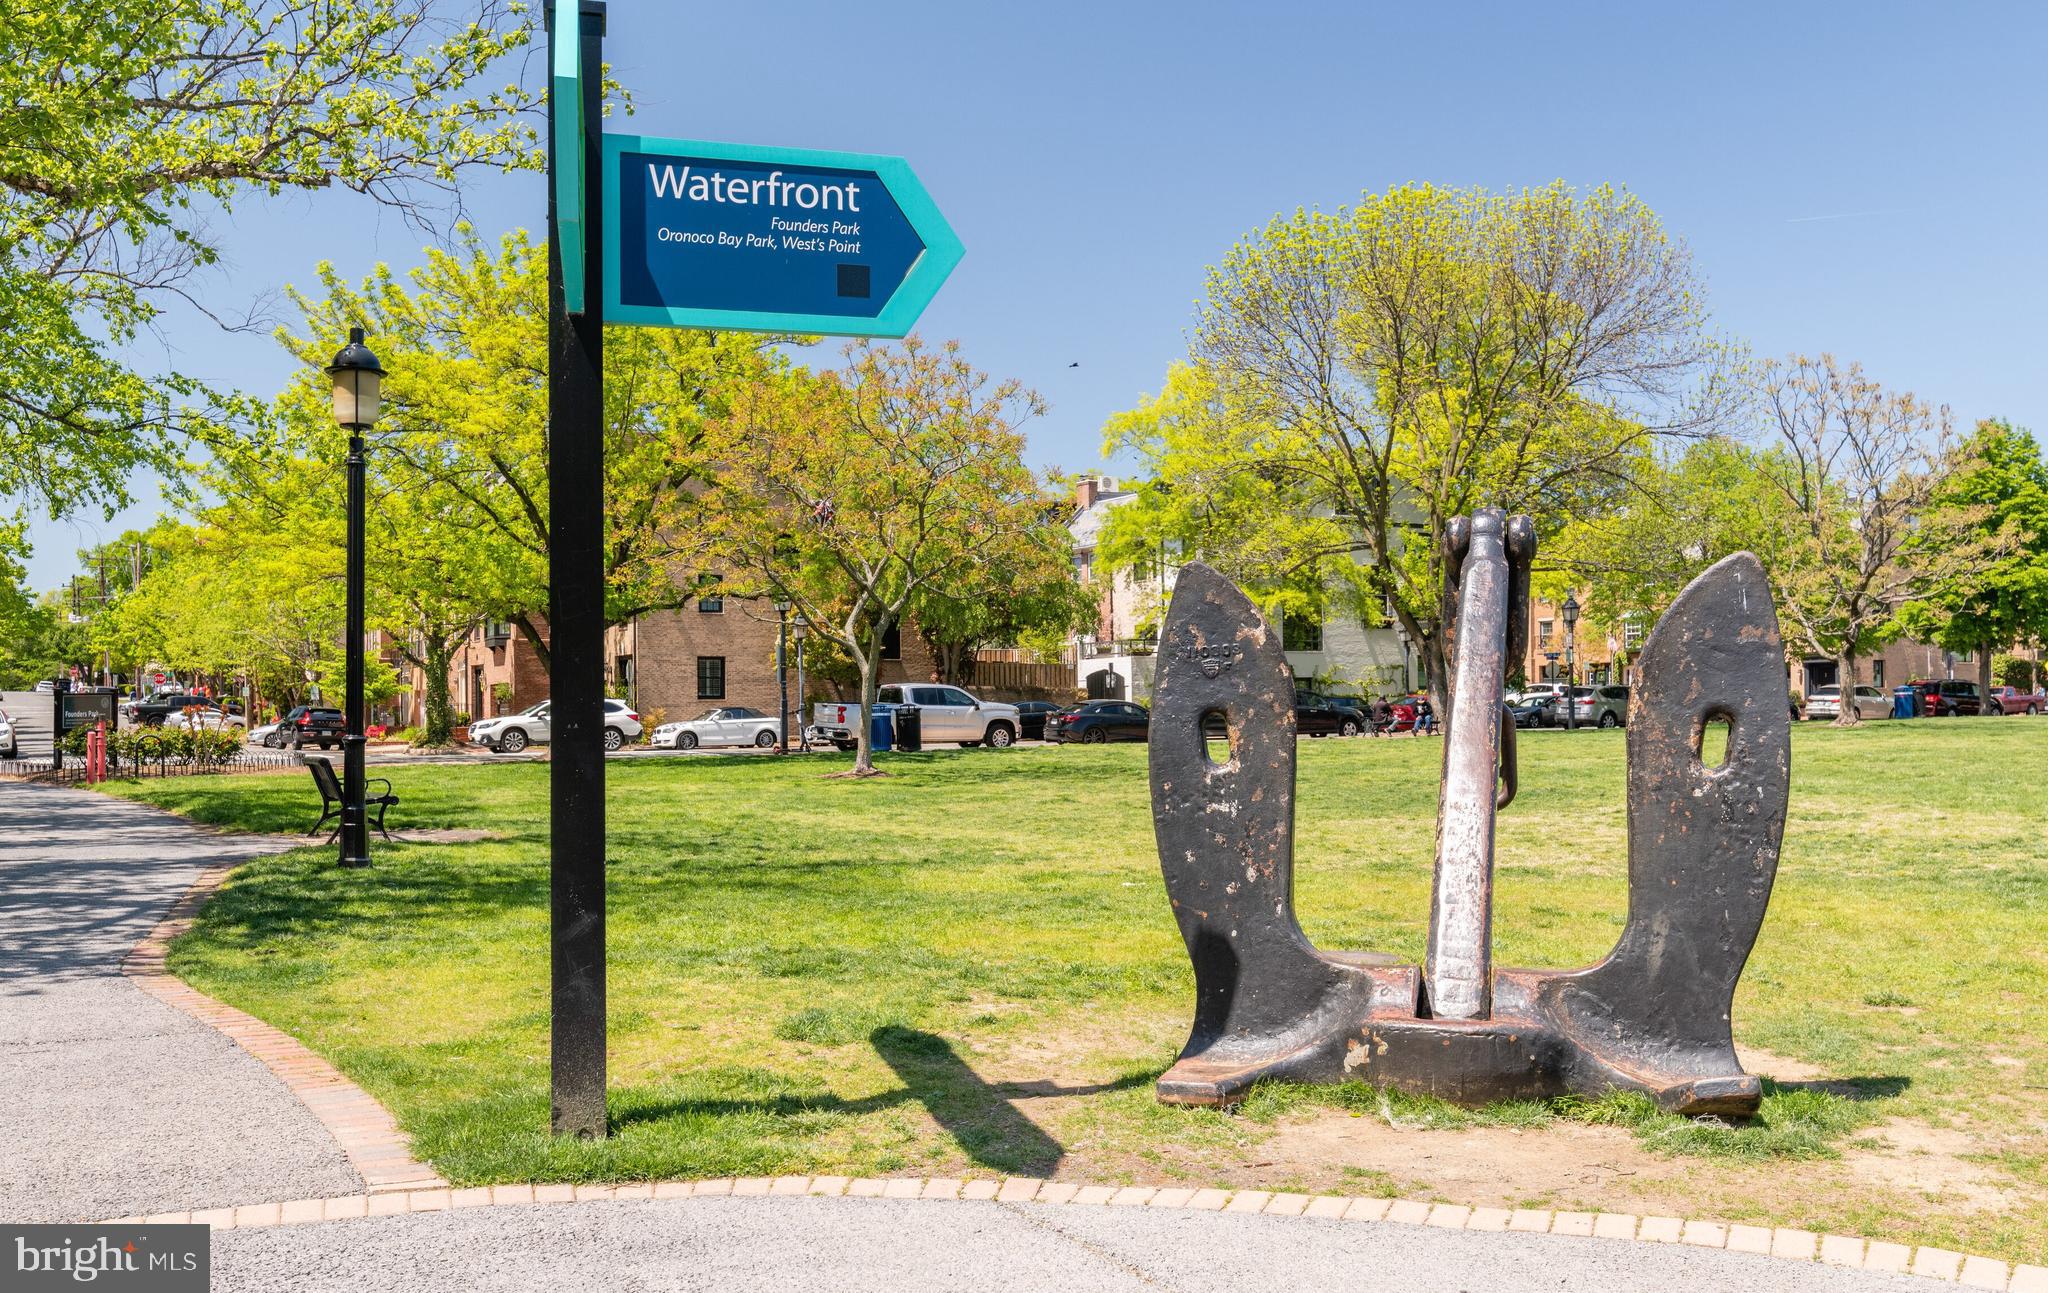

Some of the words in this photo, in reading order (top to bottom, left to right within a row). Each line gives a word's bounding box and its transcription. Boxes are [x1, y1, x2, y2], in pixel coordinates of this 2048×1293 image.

[648, 163, 861, 213] Waterfront
[771, 216, 829, 234] Founders
[832, 221, 861, 236] Park
[657, 227, 715, 246] Oronoco
[717, 231, 743, 249] Bay
[746, 233, 778, 251] Park,
[782, 236, 825, 252] West's
[828, 239, 861, 254] Point
[65, 710, 88, 718] Founders
